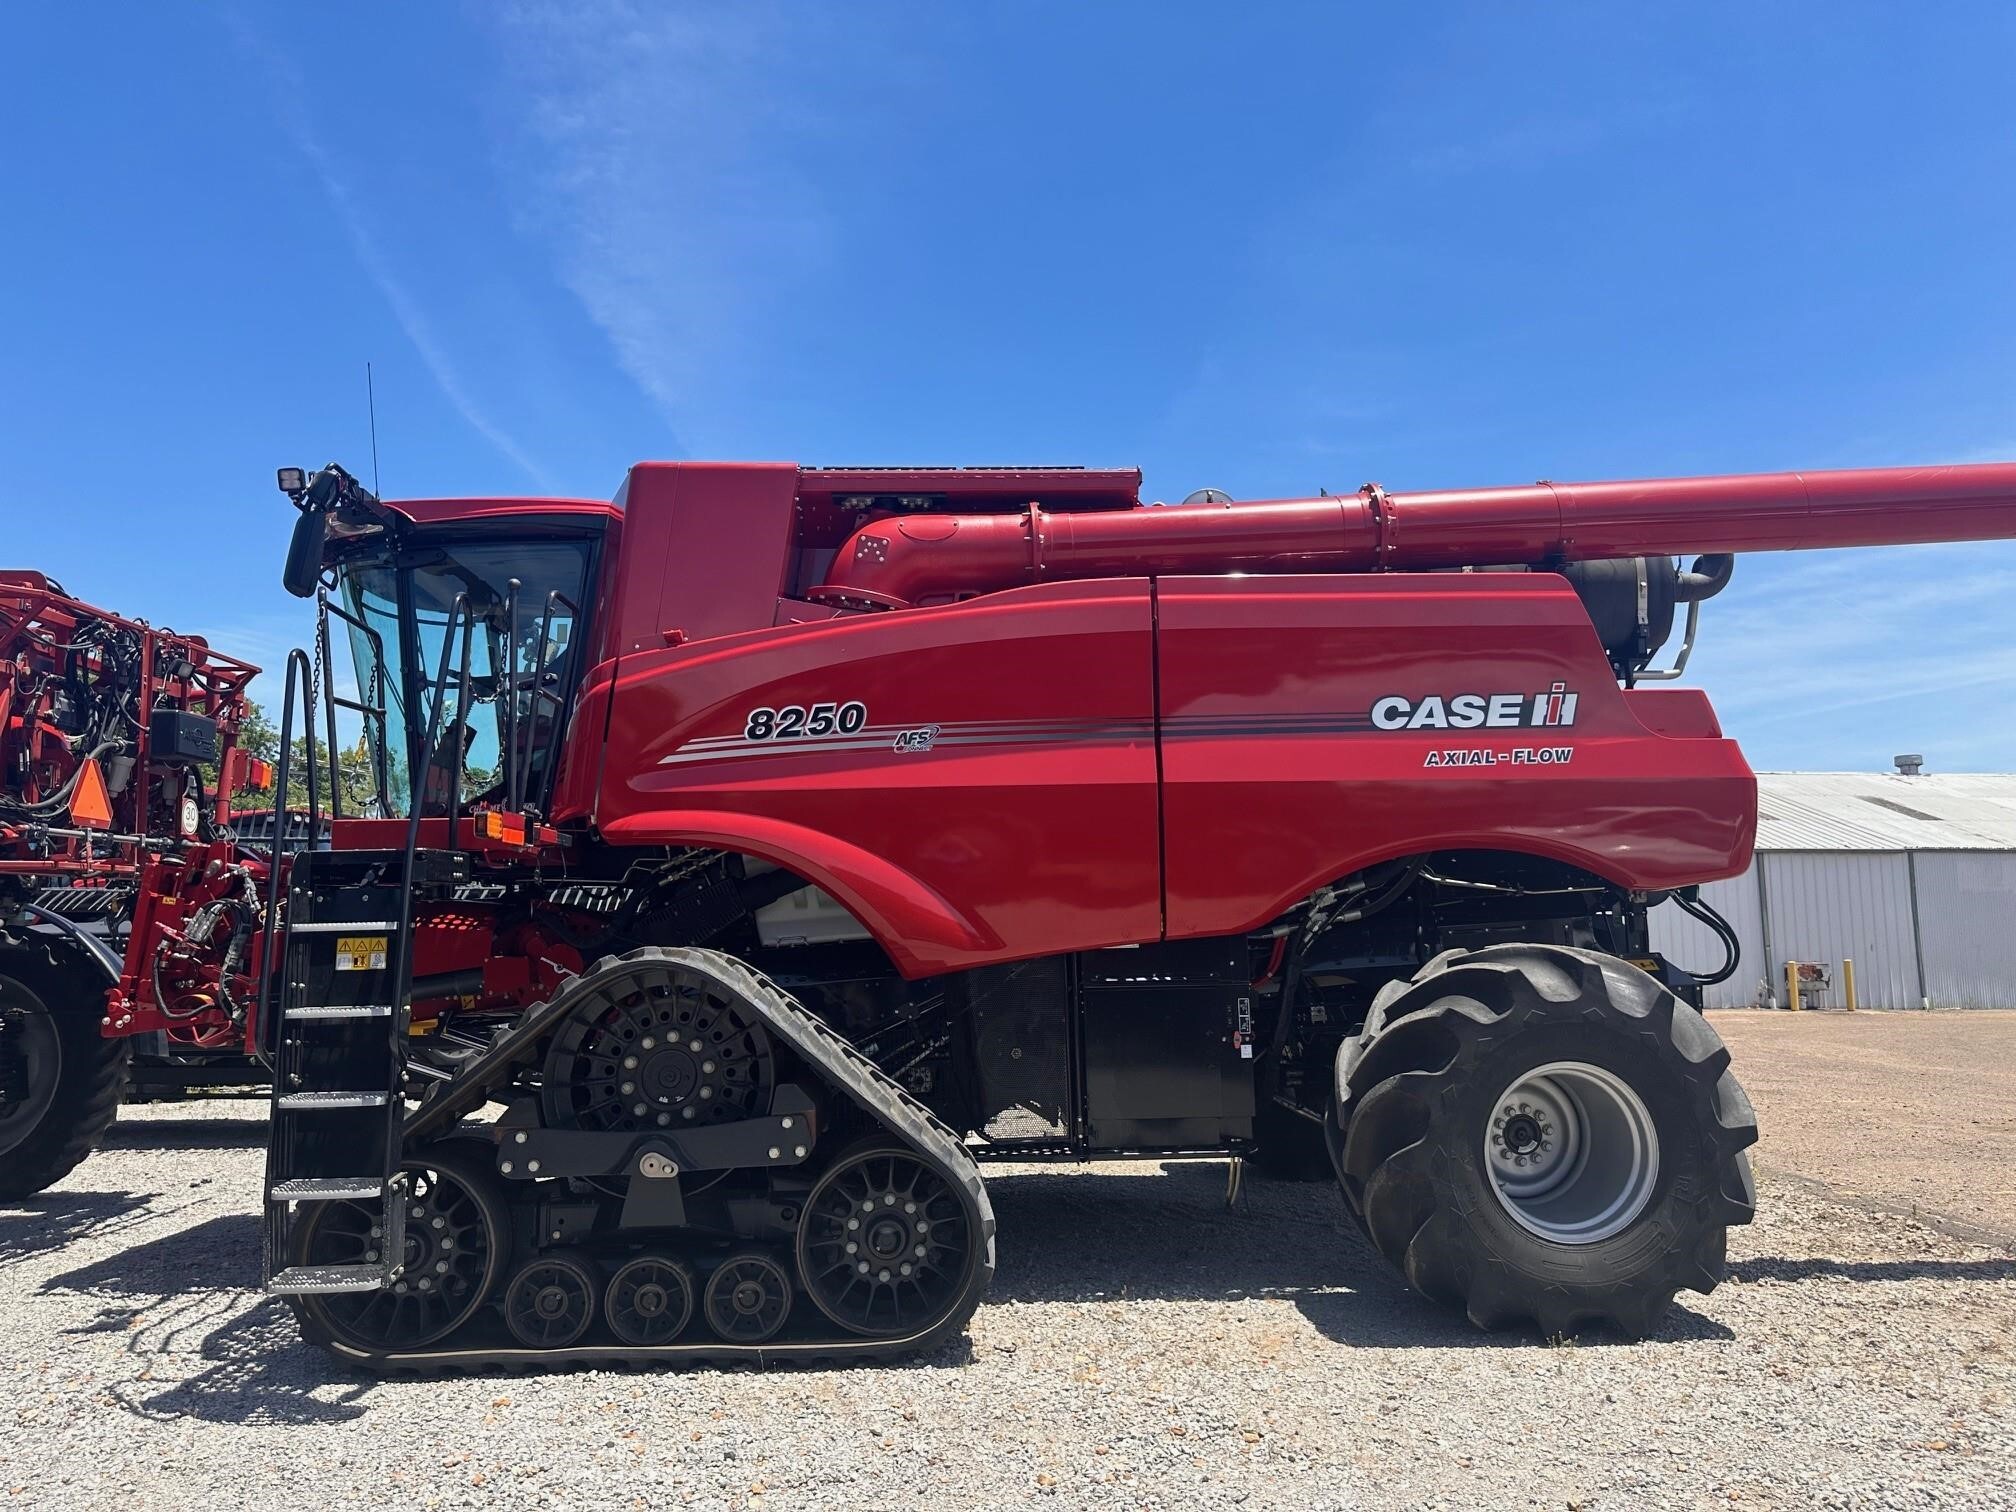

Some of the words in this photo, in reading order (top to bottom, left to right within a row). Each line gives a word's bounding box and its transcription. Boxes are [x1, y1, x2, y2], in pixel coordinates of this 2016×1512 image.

[745, 701, 867, 740] 8250
[1371, 694, 1524, 730] CASE
[894, 730, 931, 746] AFS
[1424, 747, 1573, 767] AXIAL-FLOW
[185, 806, 196, 821] 30
